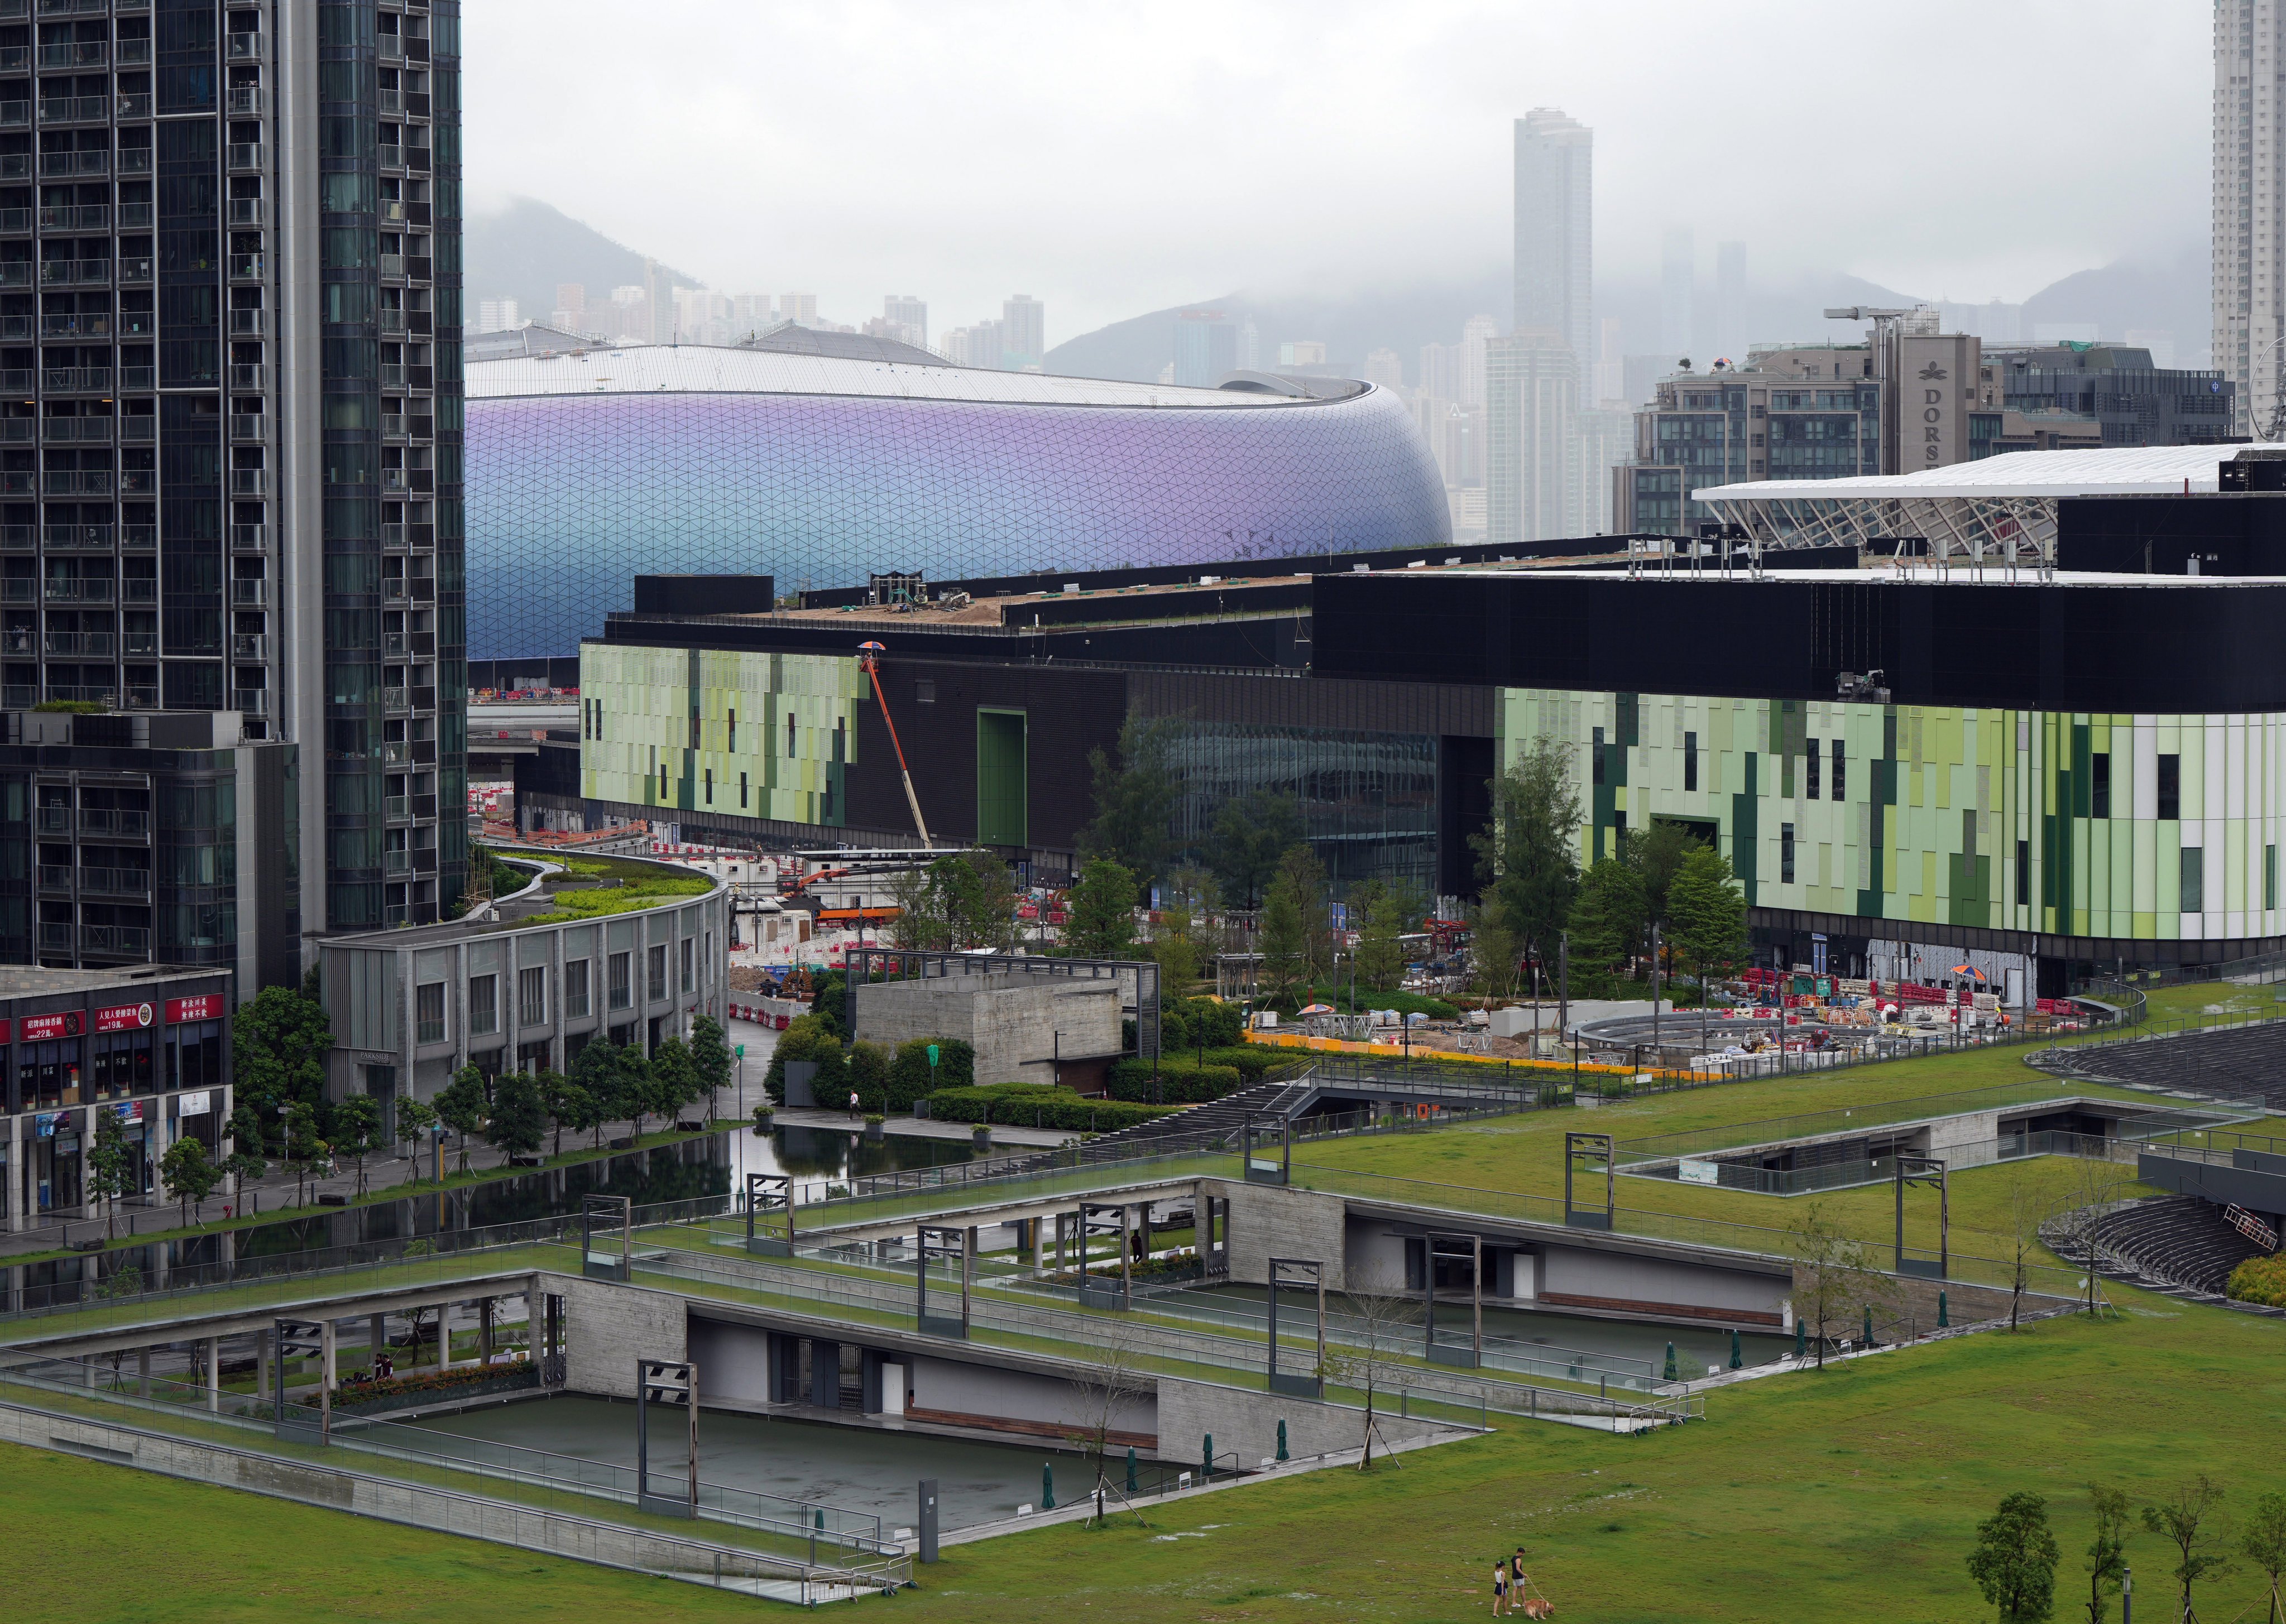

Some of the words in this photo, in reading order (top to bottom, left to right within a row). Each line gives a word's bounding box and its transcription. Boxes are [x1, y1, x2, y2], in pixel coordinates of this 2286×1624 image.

[99, 1008, 137, 1020] 人見人愛酸菜魚
[27, 1017, 62, 1029] 招牌麻辣香鍋
